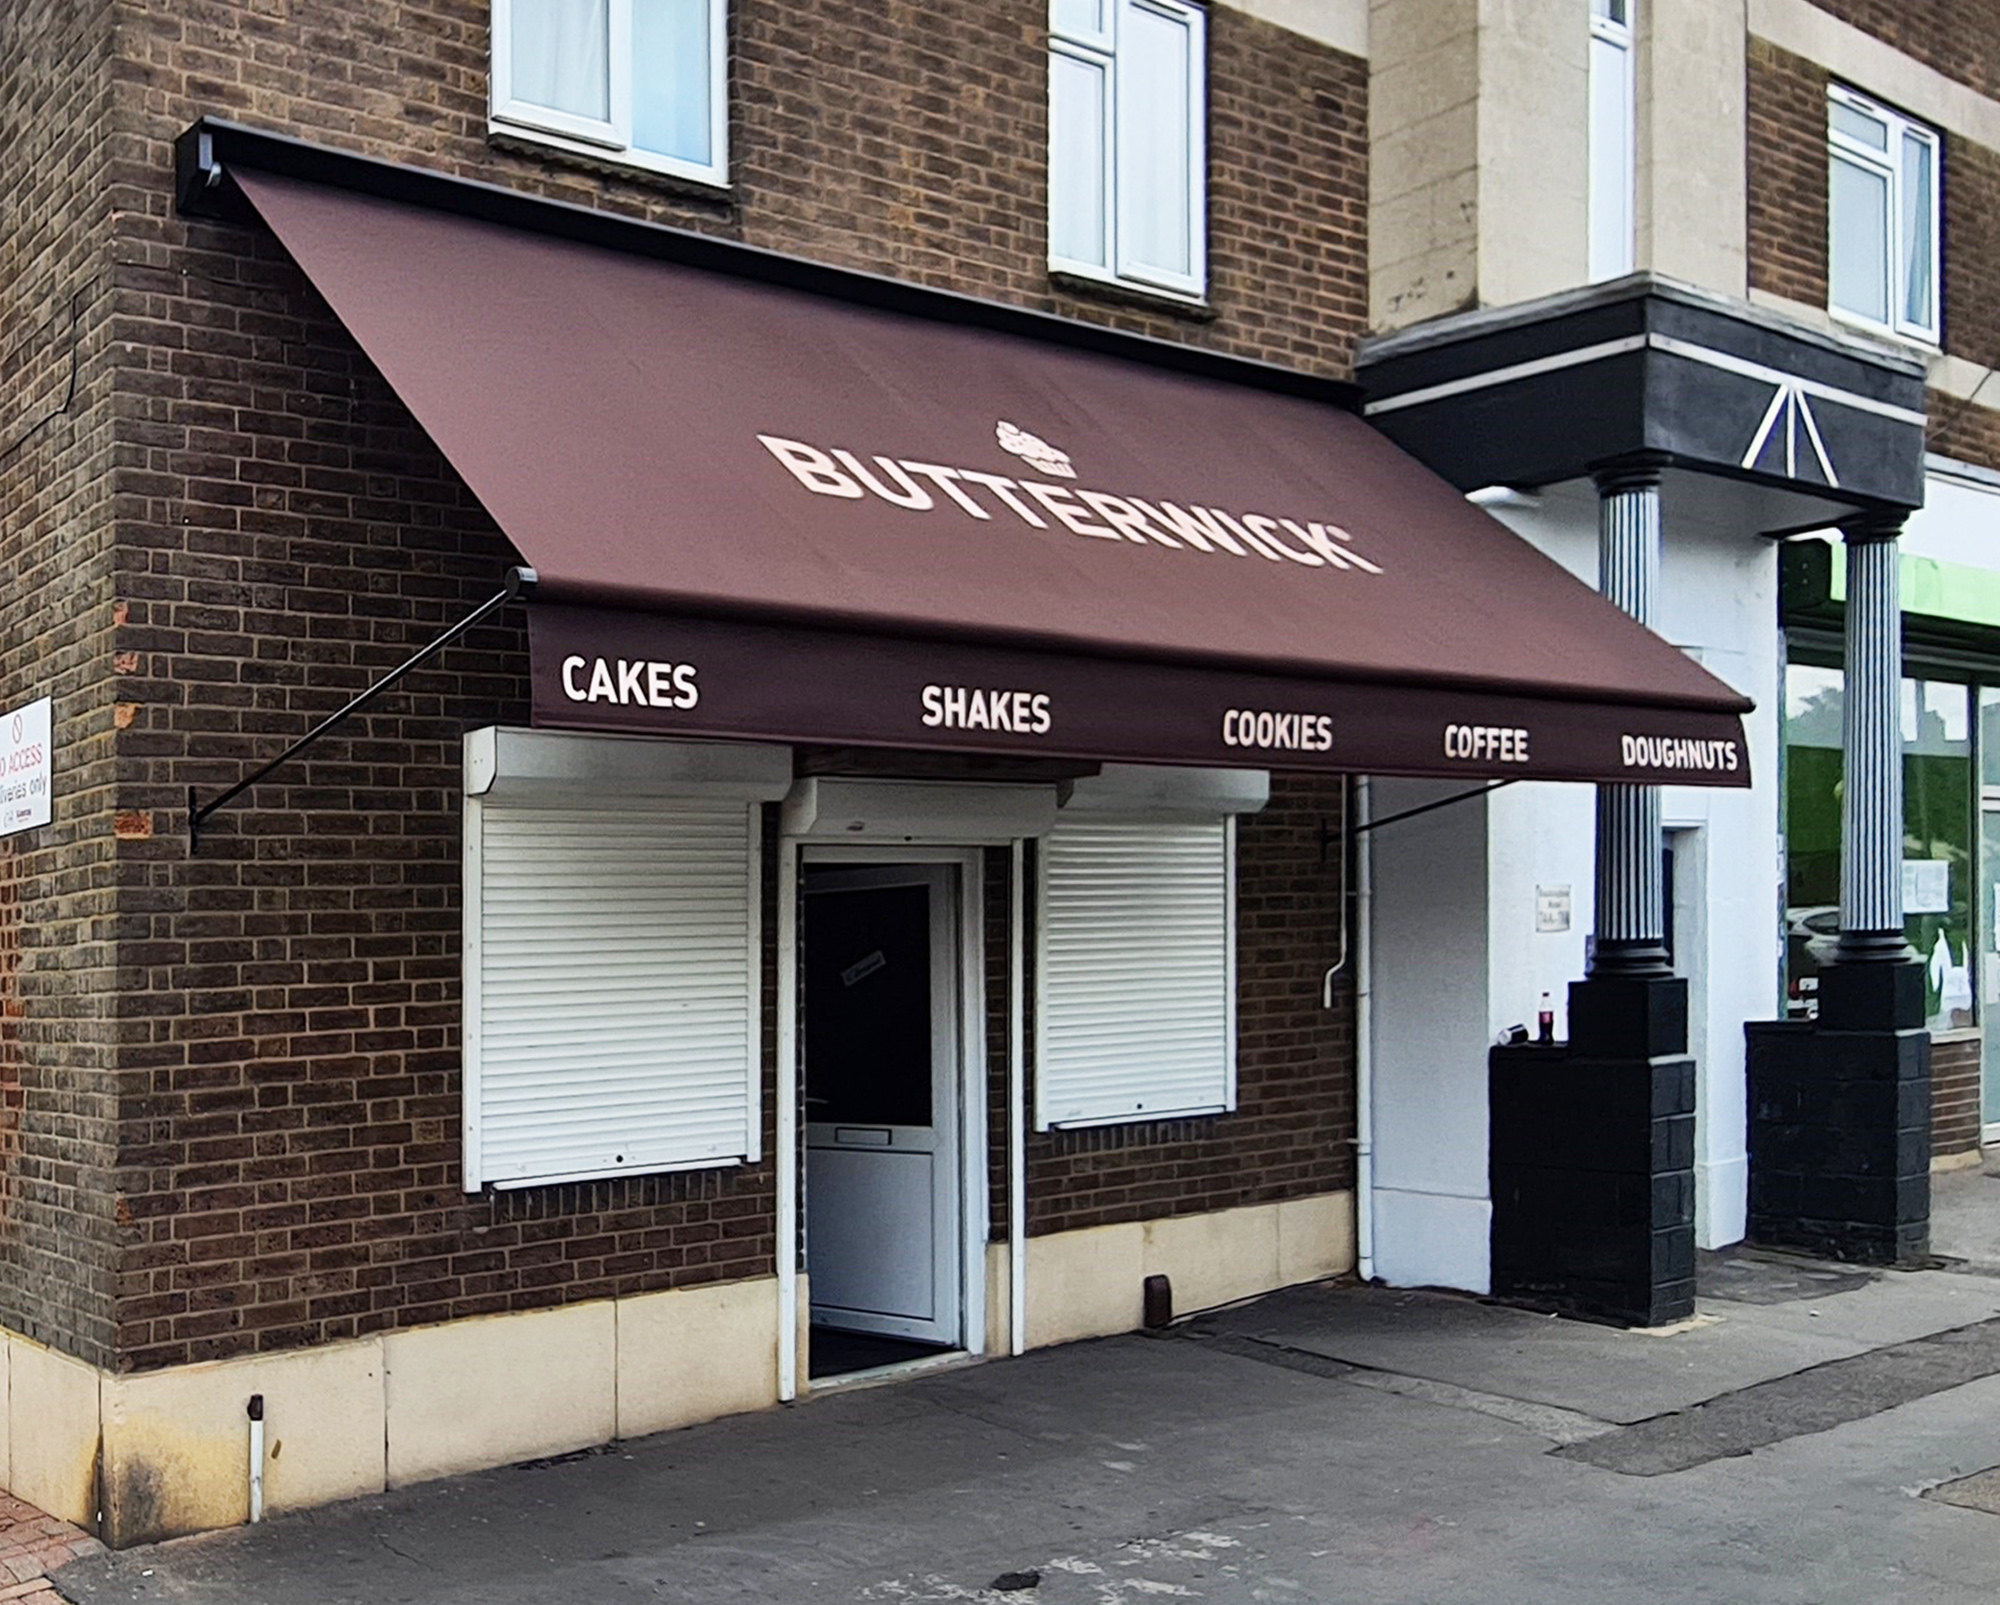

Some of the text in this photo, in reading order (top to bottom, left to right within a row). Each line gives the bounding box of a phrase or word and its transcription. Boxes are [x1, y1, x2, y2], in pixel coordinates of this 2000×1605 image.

[756, 434, 1384, 574] BUTTERWICK
[8, 742, 43, 773] ACCESS
[562, 655, 1738, 771] CAKES SHAKES COOKIES COFFEE DOUGHNUTS
